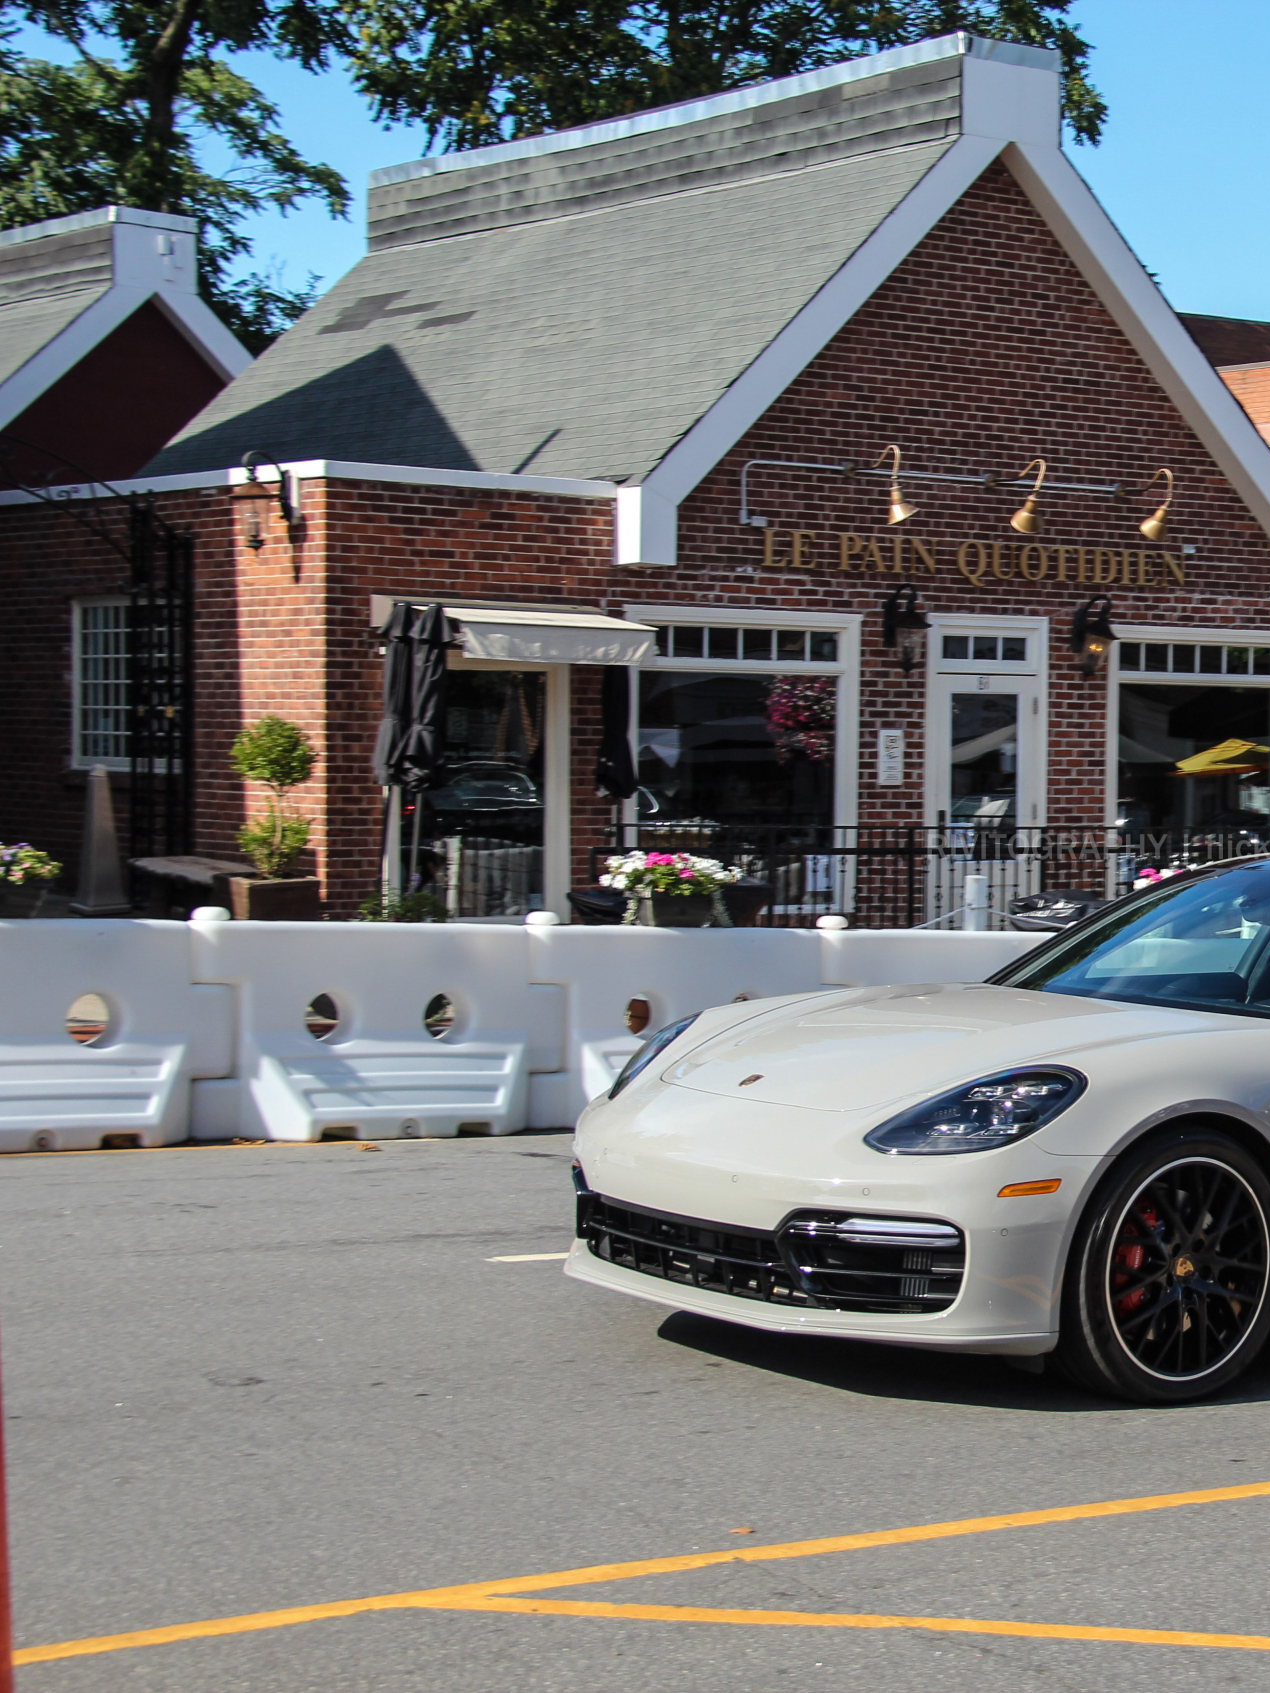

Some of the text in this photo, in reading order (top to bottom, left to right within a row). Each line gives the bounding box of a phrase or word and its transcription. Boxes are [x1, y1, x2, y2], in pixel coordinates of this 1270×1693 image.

[761, 528, 1186, 588] LE PAIN QUOTIDIEN
